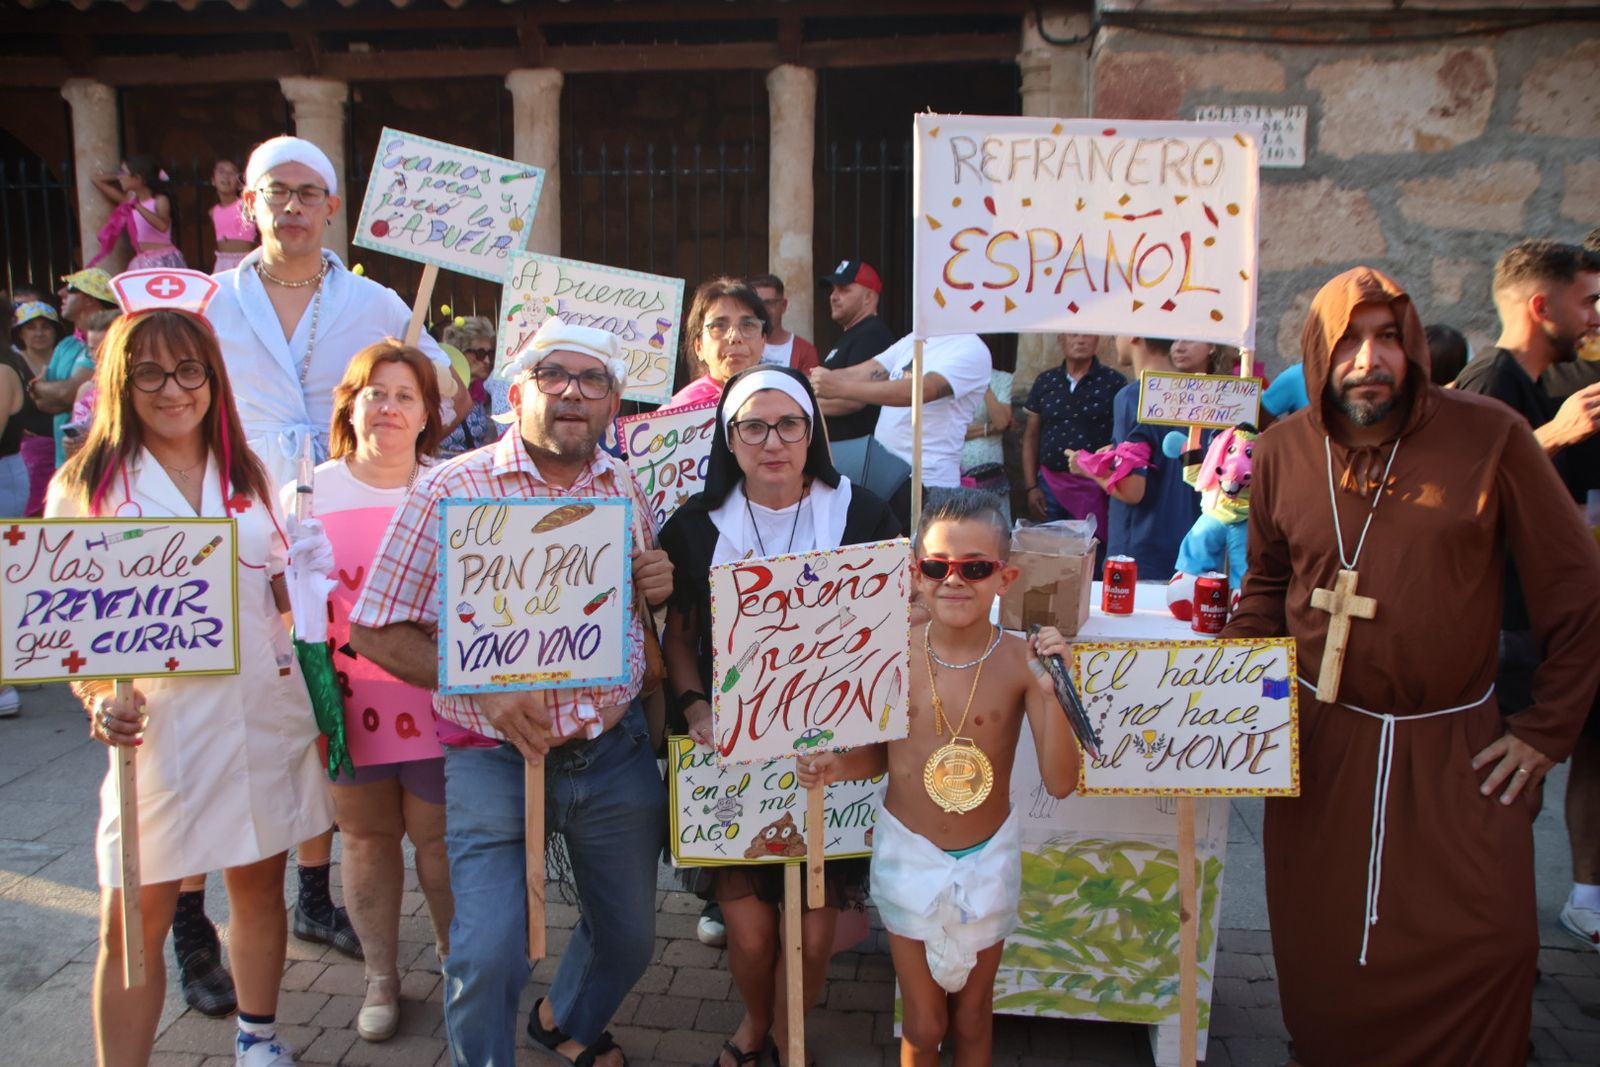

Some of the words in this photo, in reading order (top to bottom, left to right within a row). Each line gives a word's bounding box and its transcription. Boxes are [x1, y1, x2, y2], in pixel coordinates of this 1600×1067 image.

[949, 135, 1224, 187] REFRANERO
[942, 209, 1222, 295] ESPAÑOL
[512, 260, 541, 291] A
[553, 266, 665, 319] buenas
[1163, 392, 1195, 404] PARA
[629, 416, 717, 477] Coger
[449, 503, 510, 550] Al
[6, 527, 104, 584] Mas
[118, 531, 191, 578] vale
[457, 546, 535, 596] PAN
[534, 541, 612, 593] PAN
[17, 578, 210, 629] PREVENIR
[491, 595, 513, 628] y
[524, 584, 561, 616] al
[728, 556, 905, 656] Pequeño
[14, 629, 74, 671] que
[90, 616, 224, 654] CURAR
[457, 627, 531, 673] VINO
[537, 622, 602, 668] VINO
[752, 611, 892, 693] pero
[1084, 648, 1138, 695] El
[1157, 645, 1278, 689] hábito
[1118, 696, 1174, 728] no
[1178, 691, 1260, 728] hace
[676, 737, 715, 774] Par
[691, 784, 717, 801] en
[725, 772, 751, 799] el
[759, 792, 797, 814] me
[680, 822, 740, 844] CAGO
